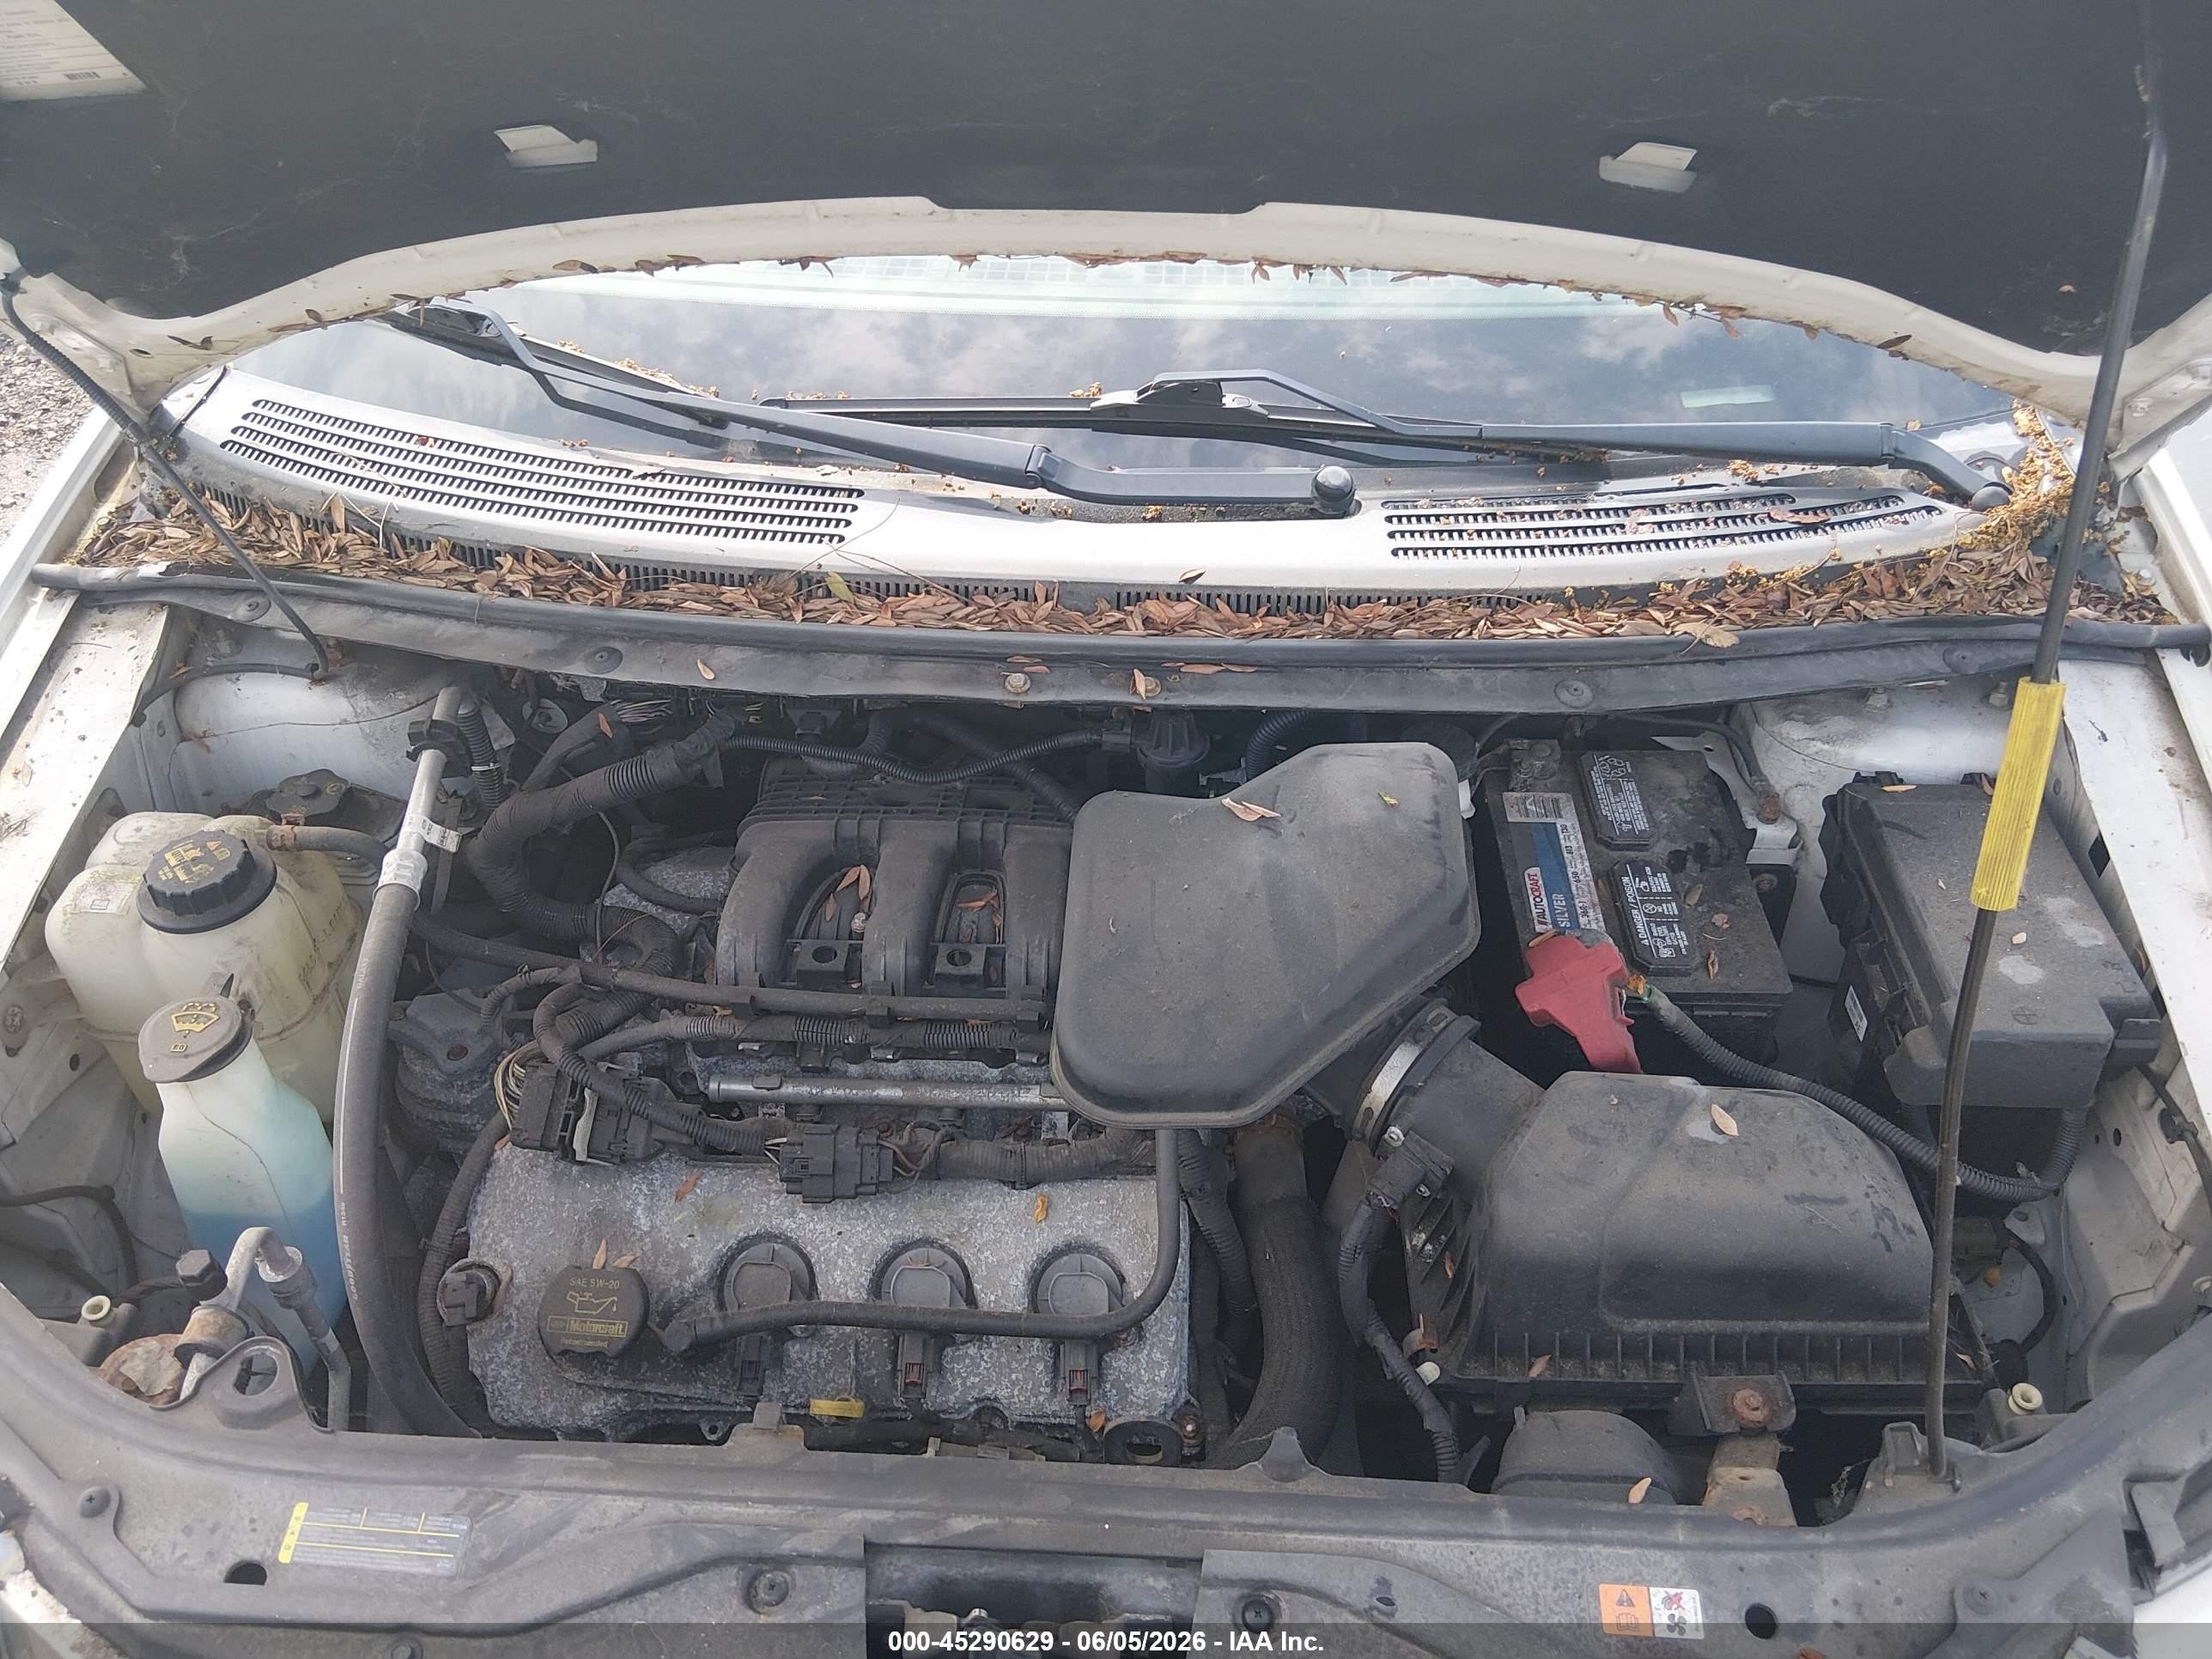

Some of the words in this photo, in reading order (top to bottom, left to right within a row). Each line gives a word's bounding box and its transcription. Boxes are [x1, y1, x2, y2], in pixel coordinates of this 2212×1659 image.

[1571, 871, 1581, 884] 650
[1620, 876, 1636, 902] POISON
[1527, 872, 1547, 922] AUTOCRAFT
[1552, 893, 1571, 928] SILVER
[1631, 908, 1647, 939] DANGER
[343, 1234, 358, 1301] GOODYEAR
[569, 1277, 589, 1287] SAE
[590, 1278, 620, 1290] 5W-20
[569, 1319, 625, 1336] Motorcraft
